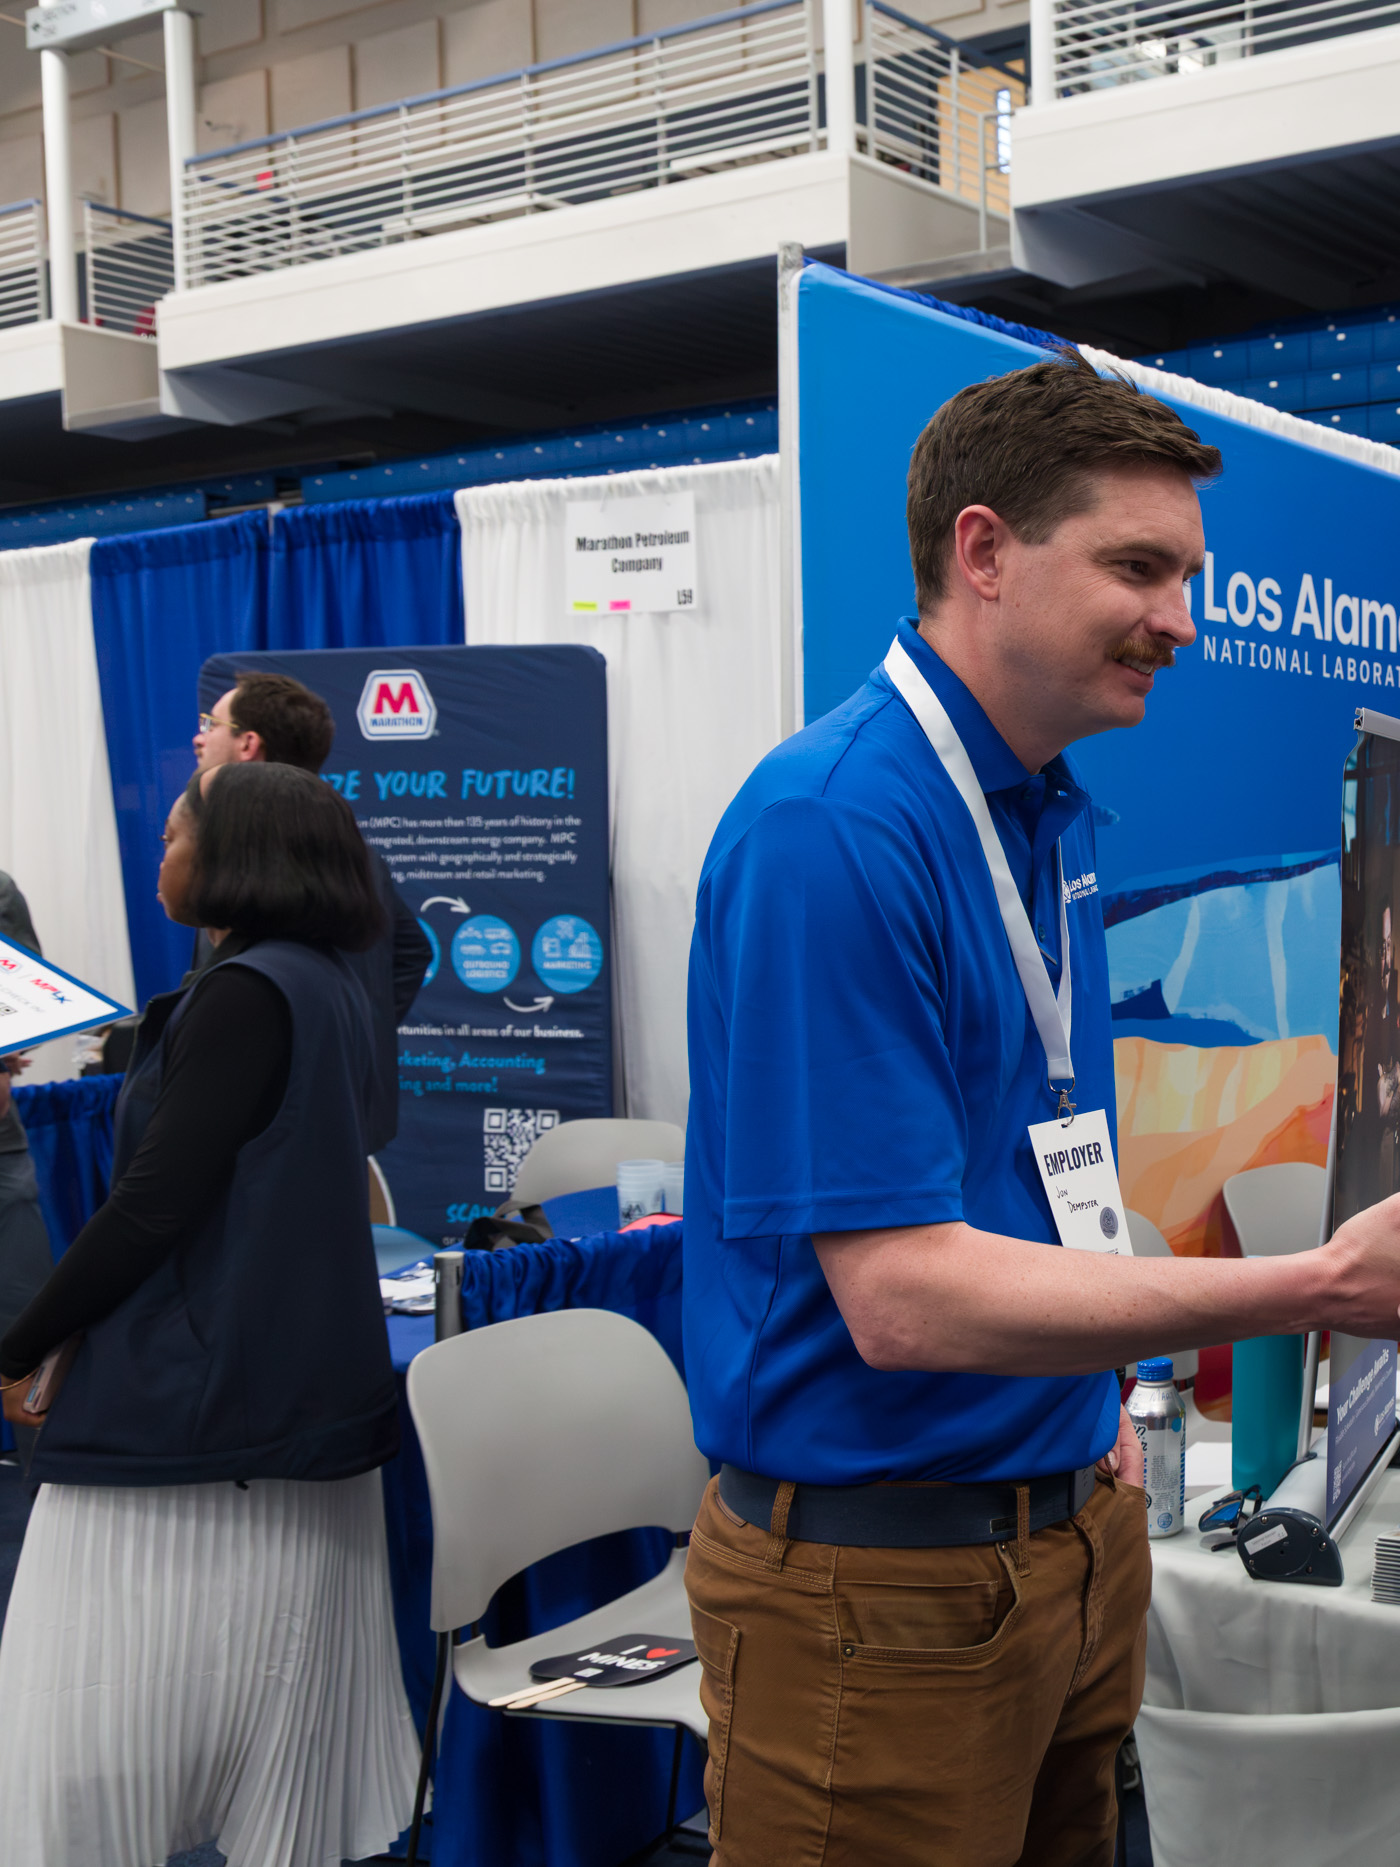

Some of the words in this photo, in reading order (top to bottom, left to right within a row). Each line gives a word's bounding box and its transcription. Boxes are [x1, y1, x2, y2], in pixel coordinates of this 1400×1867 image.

[575, 535, 633, 552] Marathon
[635, 530, 690, 548] Petroleum
[611, 556, 663, 573] Company
[1204, 551, 1283, 632] Los
[1204, 635, 1313, 676] NATIONAL
[372, 683, 420, 714] M
[370, 717, 423, 728] MARATHON
[373, 770, 448, 800] YOUR
[461, 767, 576, 799] FUTURE!
[370, 816, 401, 829] (MPC)
[403, 817, 418, 828] has
[420, 820, 442, 828] more
[444, 816, 464, 828] than
[485, 818, 508, 830] years
[520, 814, 553, 830] history
[554, 814, 564, 827] in
[565, 814, 582, 827] the
[416, 833, 469, 846] downstream
[470, 836, 501, 849] energy
[550, 832, 577, 844] MPC
[420, 851, 438, 863] with
[440, 851, 502, 866] geographically
[504, 851, 521, 863] and
[523, 850, 577, 866] strategically
[407, 868, 453, 880] midstream
[455, 868, 471, 880] and
[472, 868, 495, 880] retail
[497, 868, 546, 884] marketing.
[543, 961, 592, 970] MARKETING
[397, 1024, 443, 1036] rtunities
[443, 1024, 455, 1036] in
[456, 1023, 470, 1036] all
[472, 1027, 498, 1037] areas
[500, 1024, 513, 1037] of
[513, 1027, 532, 1037] our
[533, 1024, 584, 1038] business.
[397, 1050, 457, 1074] rketing,
[458, 1051, 545, 1075] Accounting
[425, 1076, 452, 1093] and
[455, 1076, 500, 1093] more!
[1044, 1142, 1104, 1177] EMPLOYER
[1349, 1367, 1374, 1408] Challenge
[577, 1652, 667, 1671] MINES
